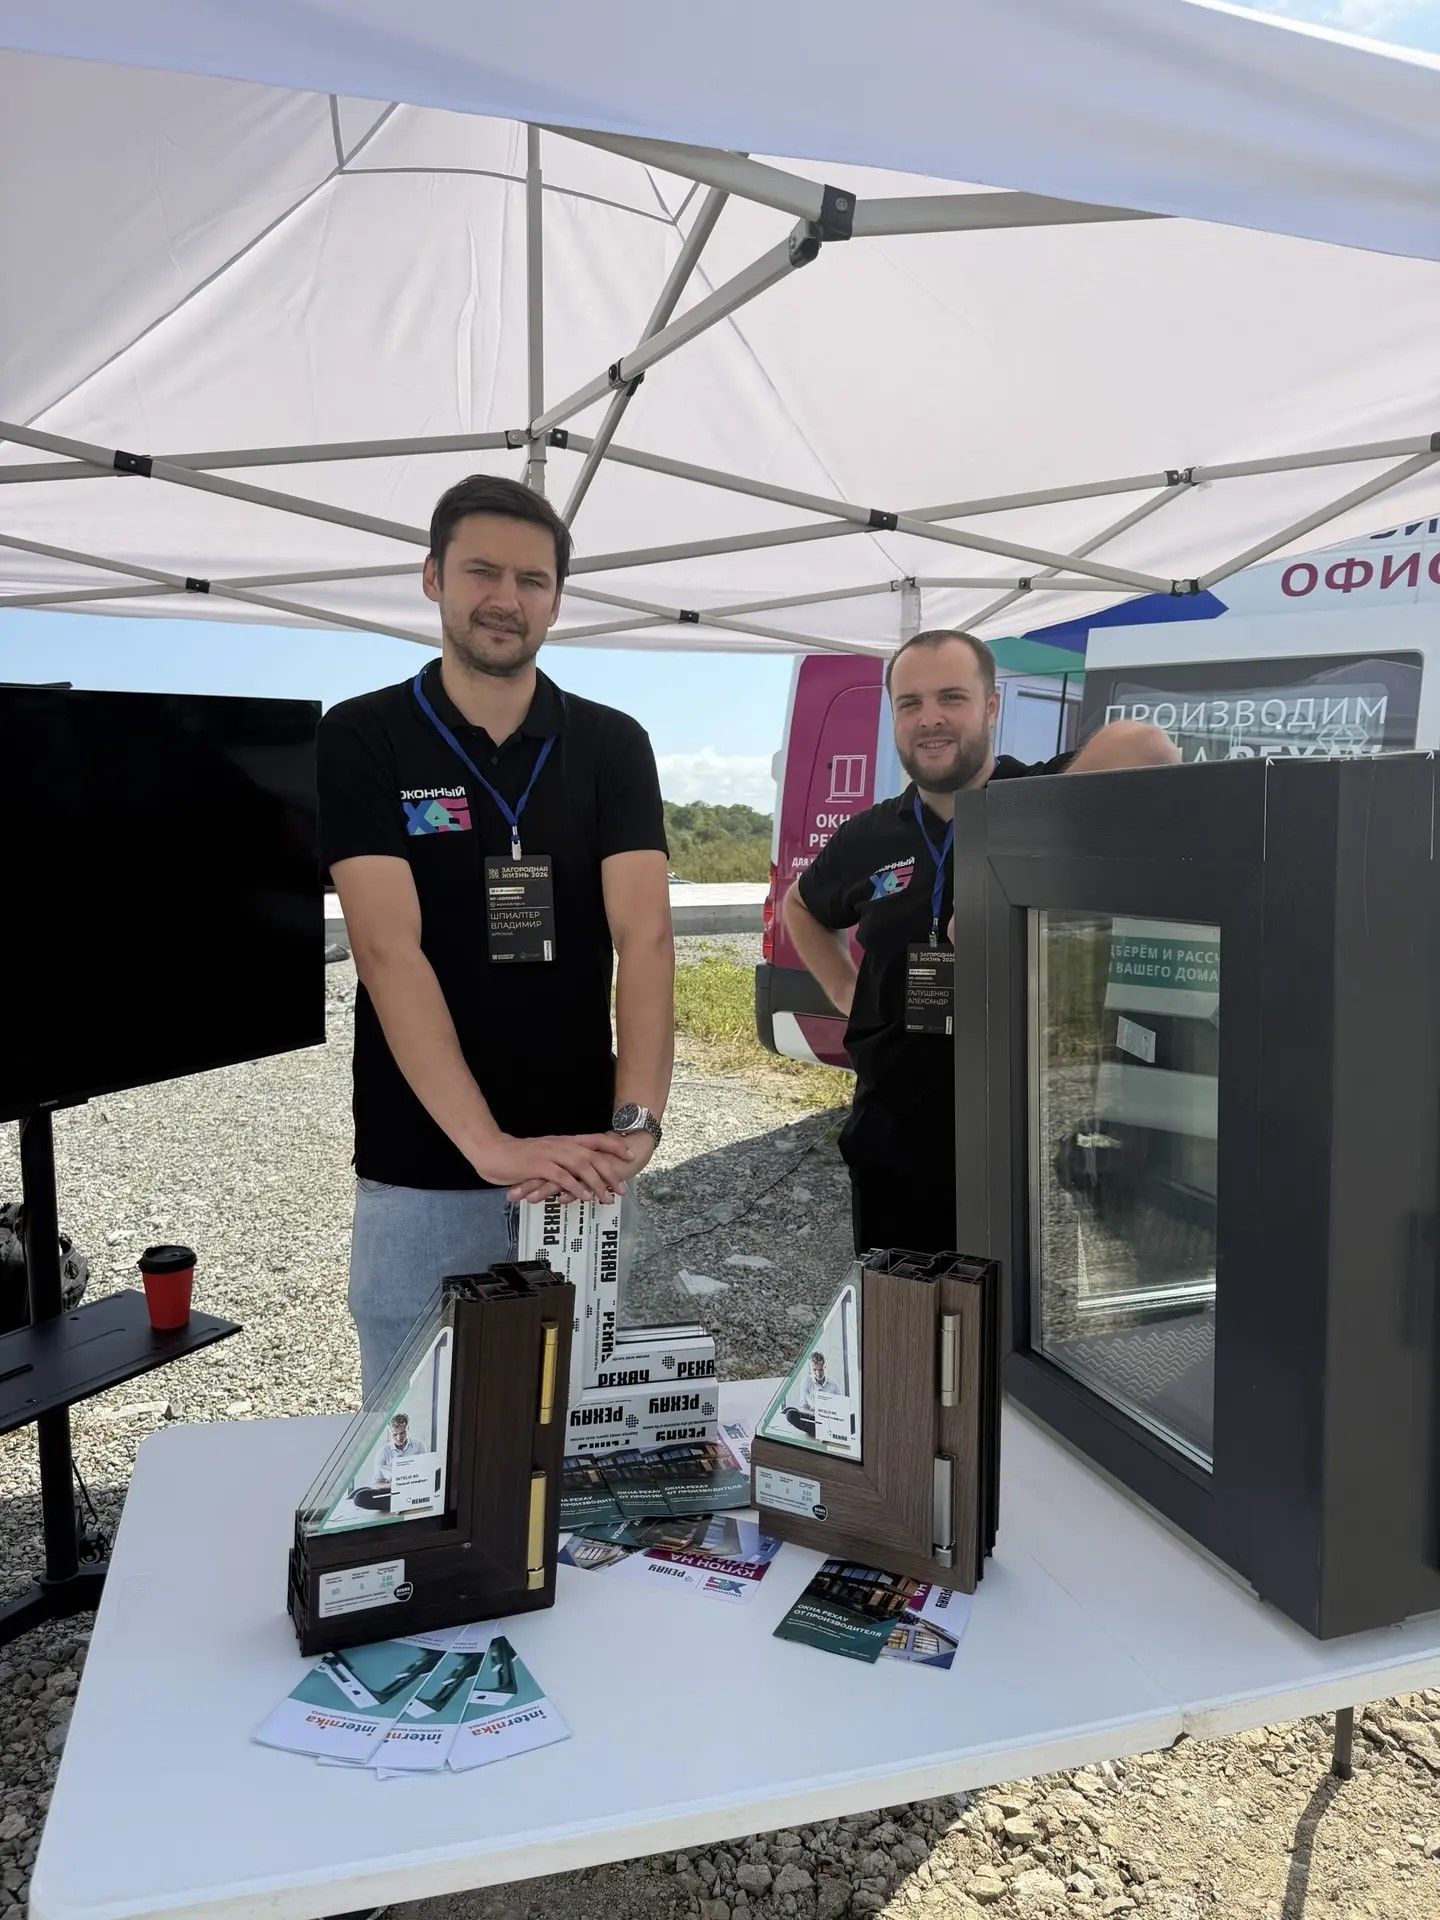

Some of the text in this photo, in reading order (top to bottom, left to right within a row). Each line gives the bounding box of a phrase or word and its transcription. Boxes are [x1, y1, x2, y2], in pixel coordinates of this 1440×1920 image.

[1104, 696, 1388, 731] ПРОИЗВОДИМ
[400, 786, 466, 800] ОКОННЫЙ
[809, 833, 833, 848] РЕ
[792, 857, 809, 868] ДЛЯ
[875, 856, 915, 873] ОННЫЙ
[490, 911, 540, 920] ШПИАЛТЕР
[490, 920, 542, 930] ВЛАДИМИР
[1162, 949, 1172, 960] И
[1116, 962, 1218, 982] ВАШЕГО ДОМА
[600, 1230, 618, 1283] РЕХАУ
[598, 1369, 650, 1388] РЕХАУ
[649, 1394, 700, 1414] РЕХАУ
[570, 1406, 623, 1427] РЕХАУ
[671, 1552, 694, 1563] НА
[648, 1564, 686, 1578] РЕХАУ
[697, 1560, 755, 1577] КУПОН
[797, 1603, 849, 1622] ОКНА РЕХАУ
[805, 1610, 882, 1637] ПРОИЗВОДИТЕЛЯ
[305, 1713, 377, 1737] internika
[471, 1707, 548, 1736] internika
